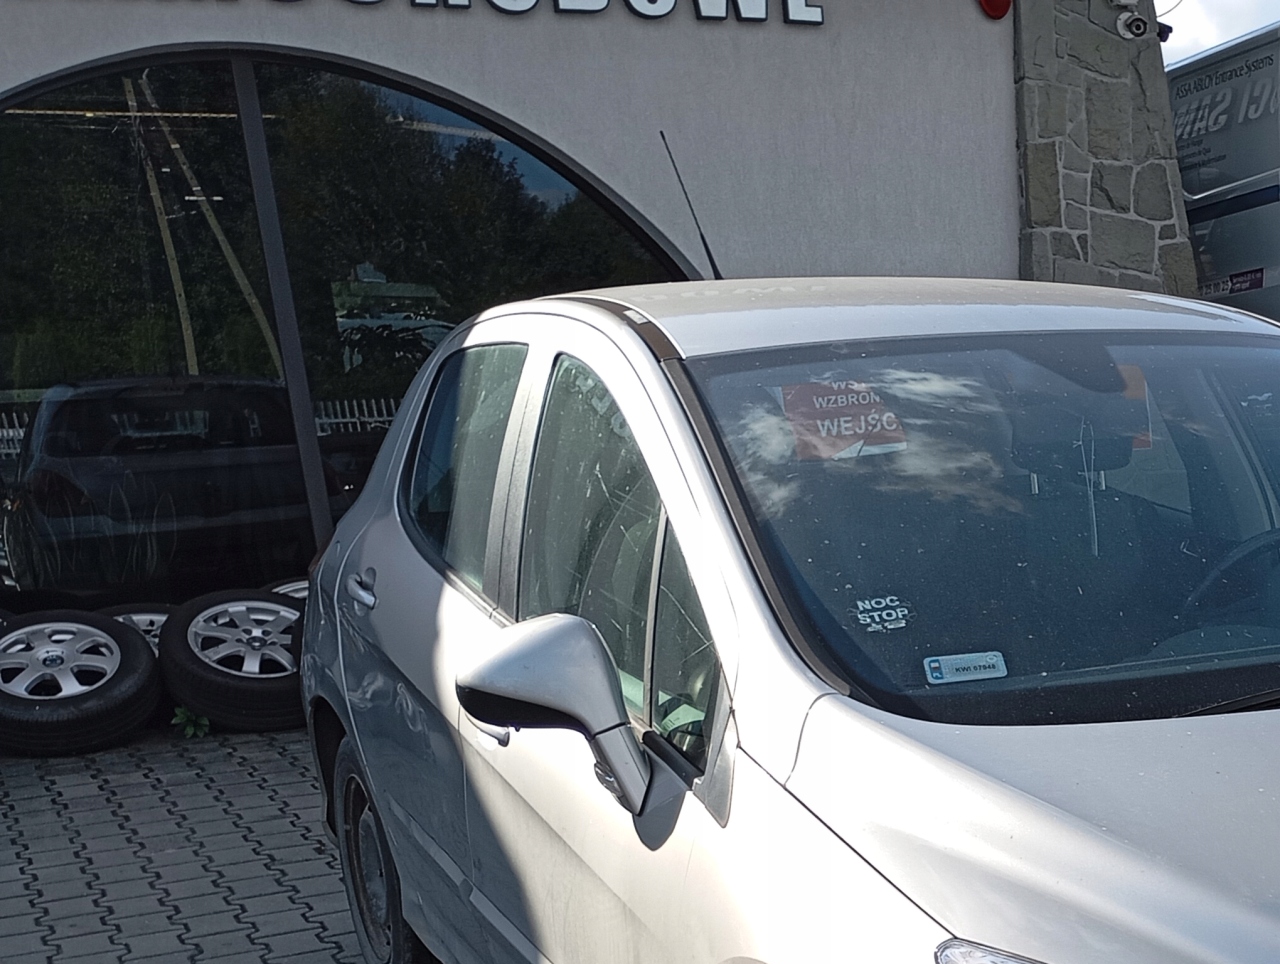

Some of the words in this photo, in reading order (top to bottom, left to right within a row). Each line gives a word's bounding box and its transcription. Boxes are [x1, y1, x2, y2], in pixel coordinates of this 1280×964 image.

[817, 408, 902, 438] WEJŚC
[856, 596, 900, 611] NOC
[857, 607, 909, 625] STOP
